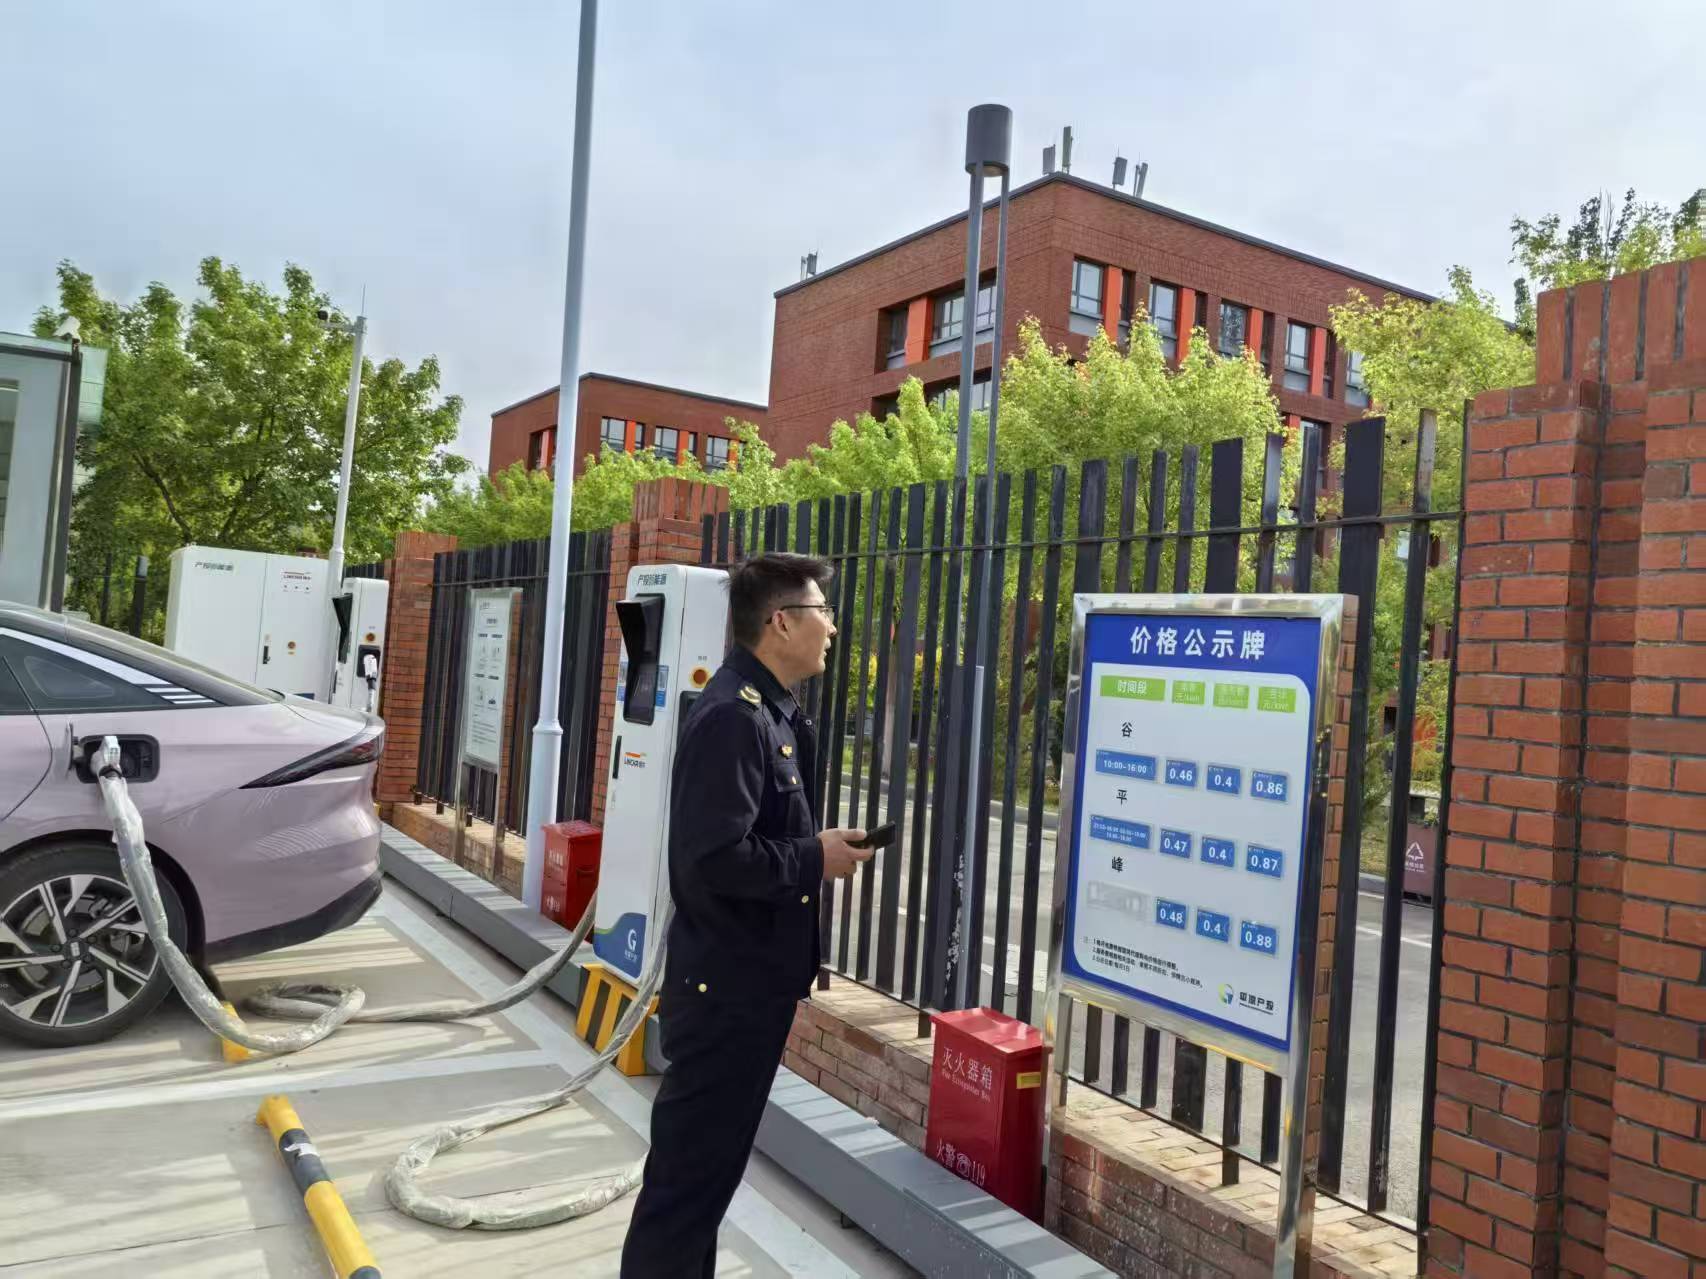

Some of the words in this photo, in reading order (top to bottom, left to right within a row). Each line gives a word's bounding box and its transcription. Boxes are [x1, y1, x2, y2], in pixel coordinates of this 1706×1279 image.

[1130, 626, 1265, 660] 价格公示牌
[1117, 680, 1147, 694] 时间段
[1122, 722, 1133, 738] 谷
[1169, 768, 1193, 782] 0.46
[1214, 774, 1232, 787] 0.4
[1256, 780, 1283, 795] 0.86
[1115, 789, 1128, 805] 平
[1164, 837, 1188, 852] 0.47
[1208, 847, 1226, 860] 0.4
[1111, 856, 1124, 872] 峰
[1251, 854, 1278, 871] 0.87
[1160, 908, 1183, 924] 0.48
[1203, 919, 1221, 934] 0.4
[1245, 931, 1272, 948] 0.88
[943, 1046, 992, 1090] 灭火器箱
[972, 1160, 986, 1186] 119
